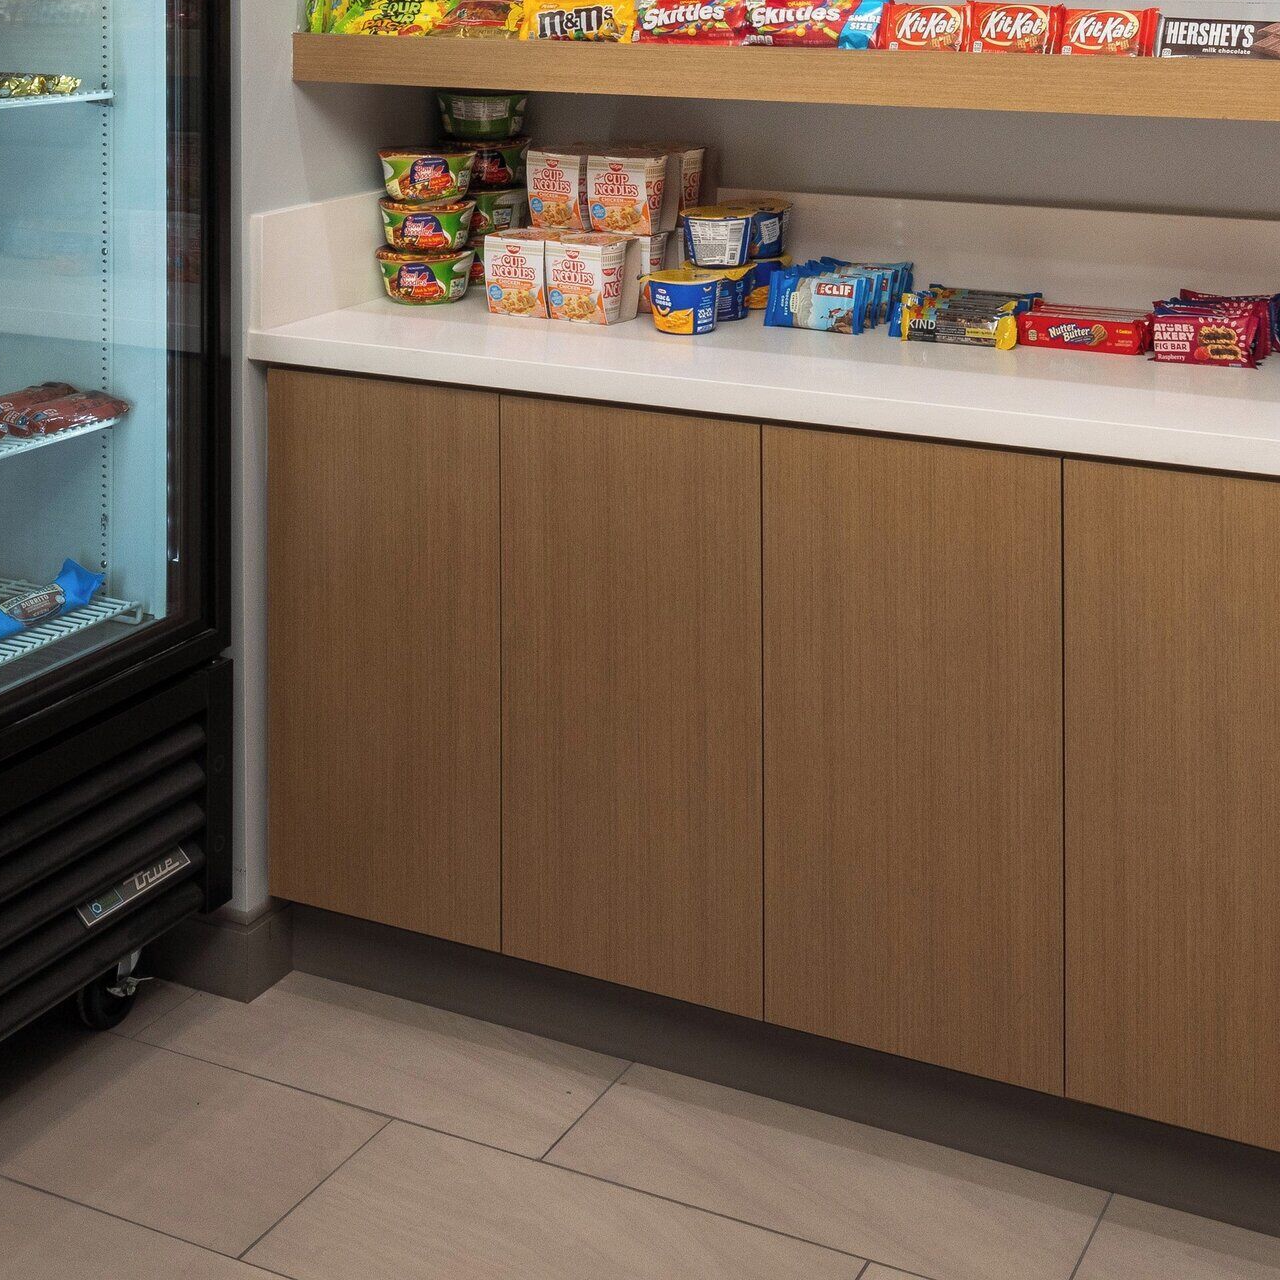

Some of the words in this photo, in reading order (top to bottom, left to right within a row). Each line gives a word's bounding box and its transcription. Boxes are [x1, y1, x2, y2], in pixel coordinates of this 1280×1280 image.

[643, 3, 725, 30] Skittles
[751, 6, 841, 28] Skittles
[849, 21, 874, 32] SIZE
[897, 12, 959, 43] KitKat
[981, 10, 1045, 41] KitKat
[1070, 16, 1135, 44] KitKat
[1168, 21, 1255, 48] HERSHEY'S
[1218, 47, 1251, 55] chocolate
[540, 168, 563, 181] CUP
[604, 172, 628, 185] CUP
[533, 178, 571, 193] NOODLES
[594, 183, 639, 197] NOODLES
[501, 254, 527, 268] CUP
[561, 259, 585, 272] CUP
[491, 264, 536, 281] NOODLES
[552, 269, 595, 286] NOODLES
[907, 319, 936, 330] KIND
[1048, 324, 1077, 339] Nutter
[1063, 327, 1091, 343] Butter
[1154, 331, 1195, 341] AKERY
[1155, 343, 1168, 351] FIG
[1169, 343, 1188, 351] BAR
[1157, 353, 1186, 361] Raspberry
[21, 594, 49, 609] BURRITO
